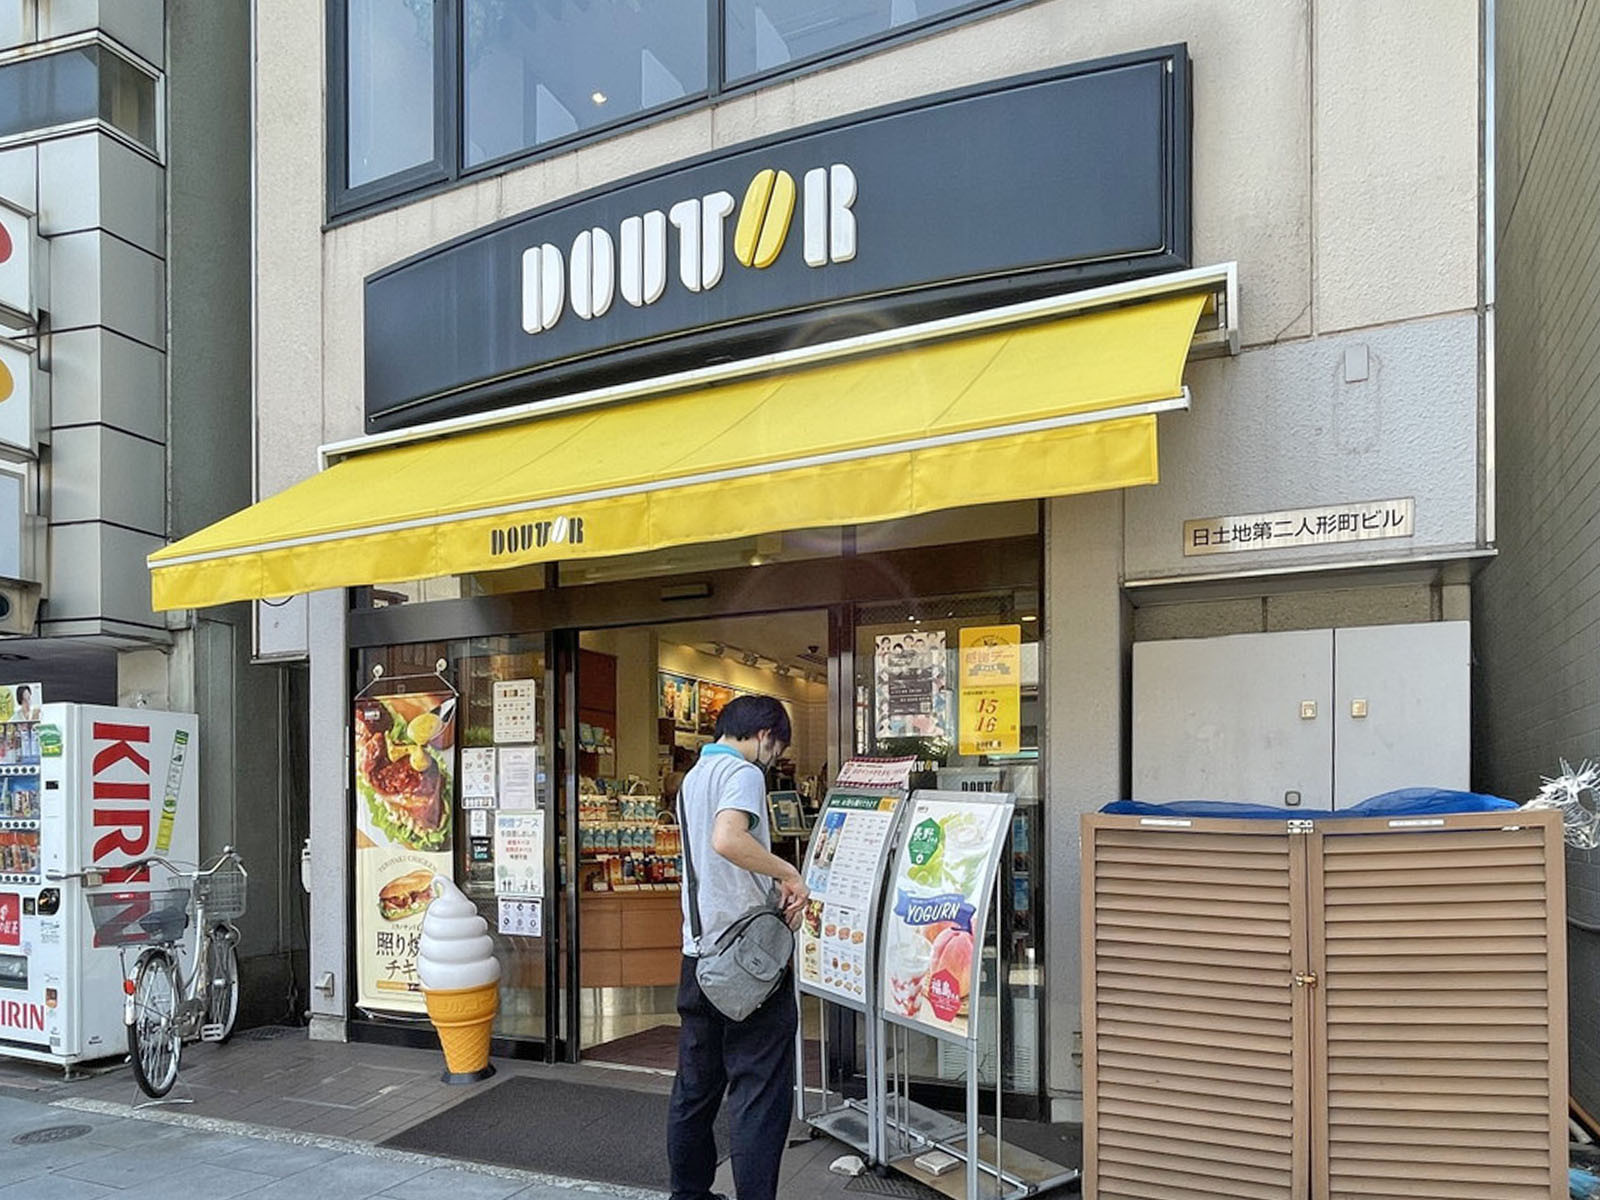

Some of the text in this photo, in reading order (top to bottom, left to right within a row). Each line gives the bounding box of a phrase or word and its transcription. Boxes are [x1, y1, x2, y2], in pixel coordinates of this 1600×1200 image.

[521, 163, 858, 335] DOUTOR
[491, 515, 584, 555] DOUTOR
[1192, 509, 1405, 547] 日土地第二人形町ビル
[978, 698, 999, 714] 15
[977, 717, 998, 732] 16
[93, 722, 151, 948] KIRIN
[906, 902, 960, 923] YOGURN
[384, 959, 420, 981] チキ
